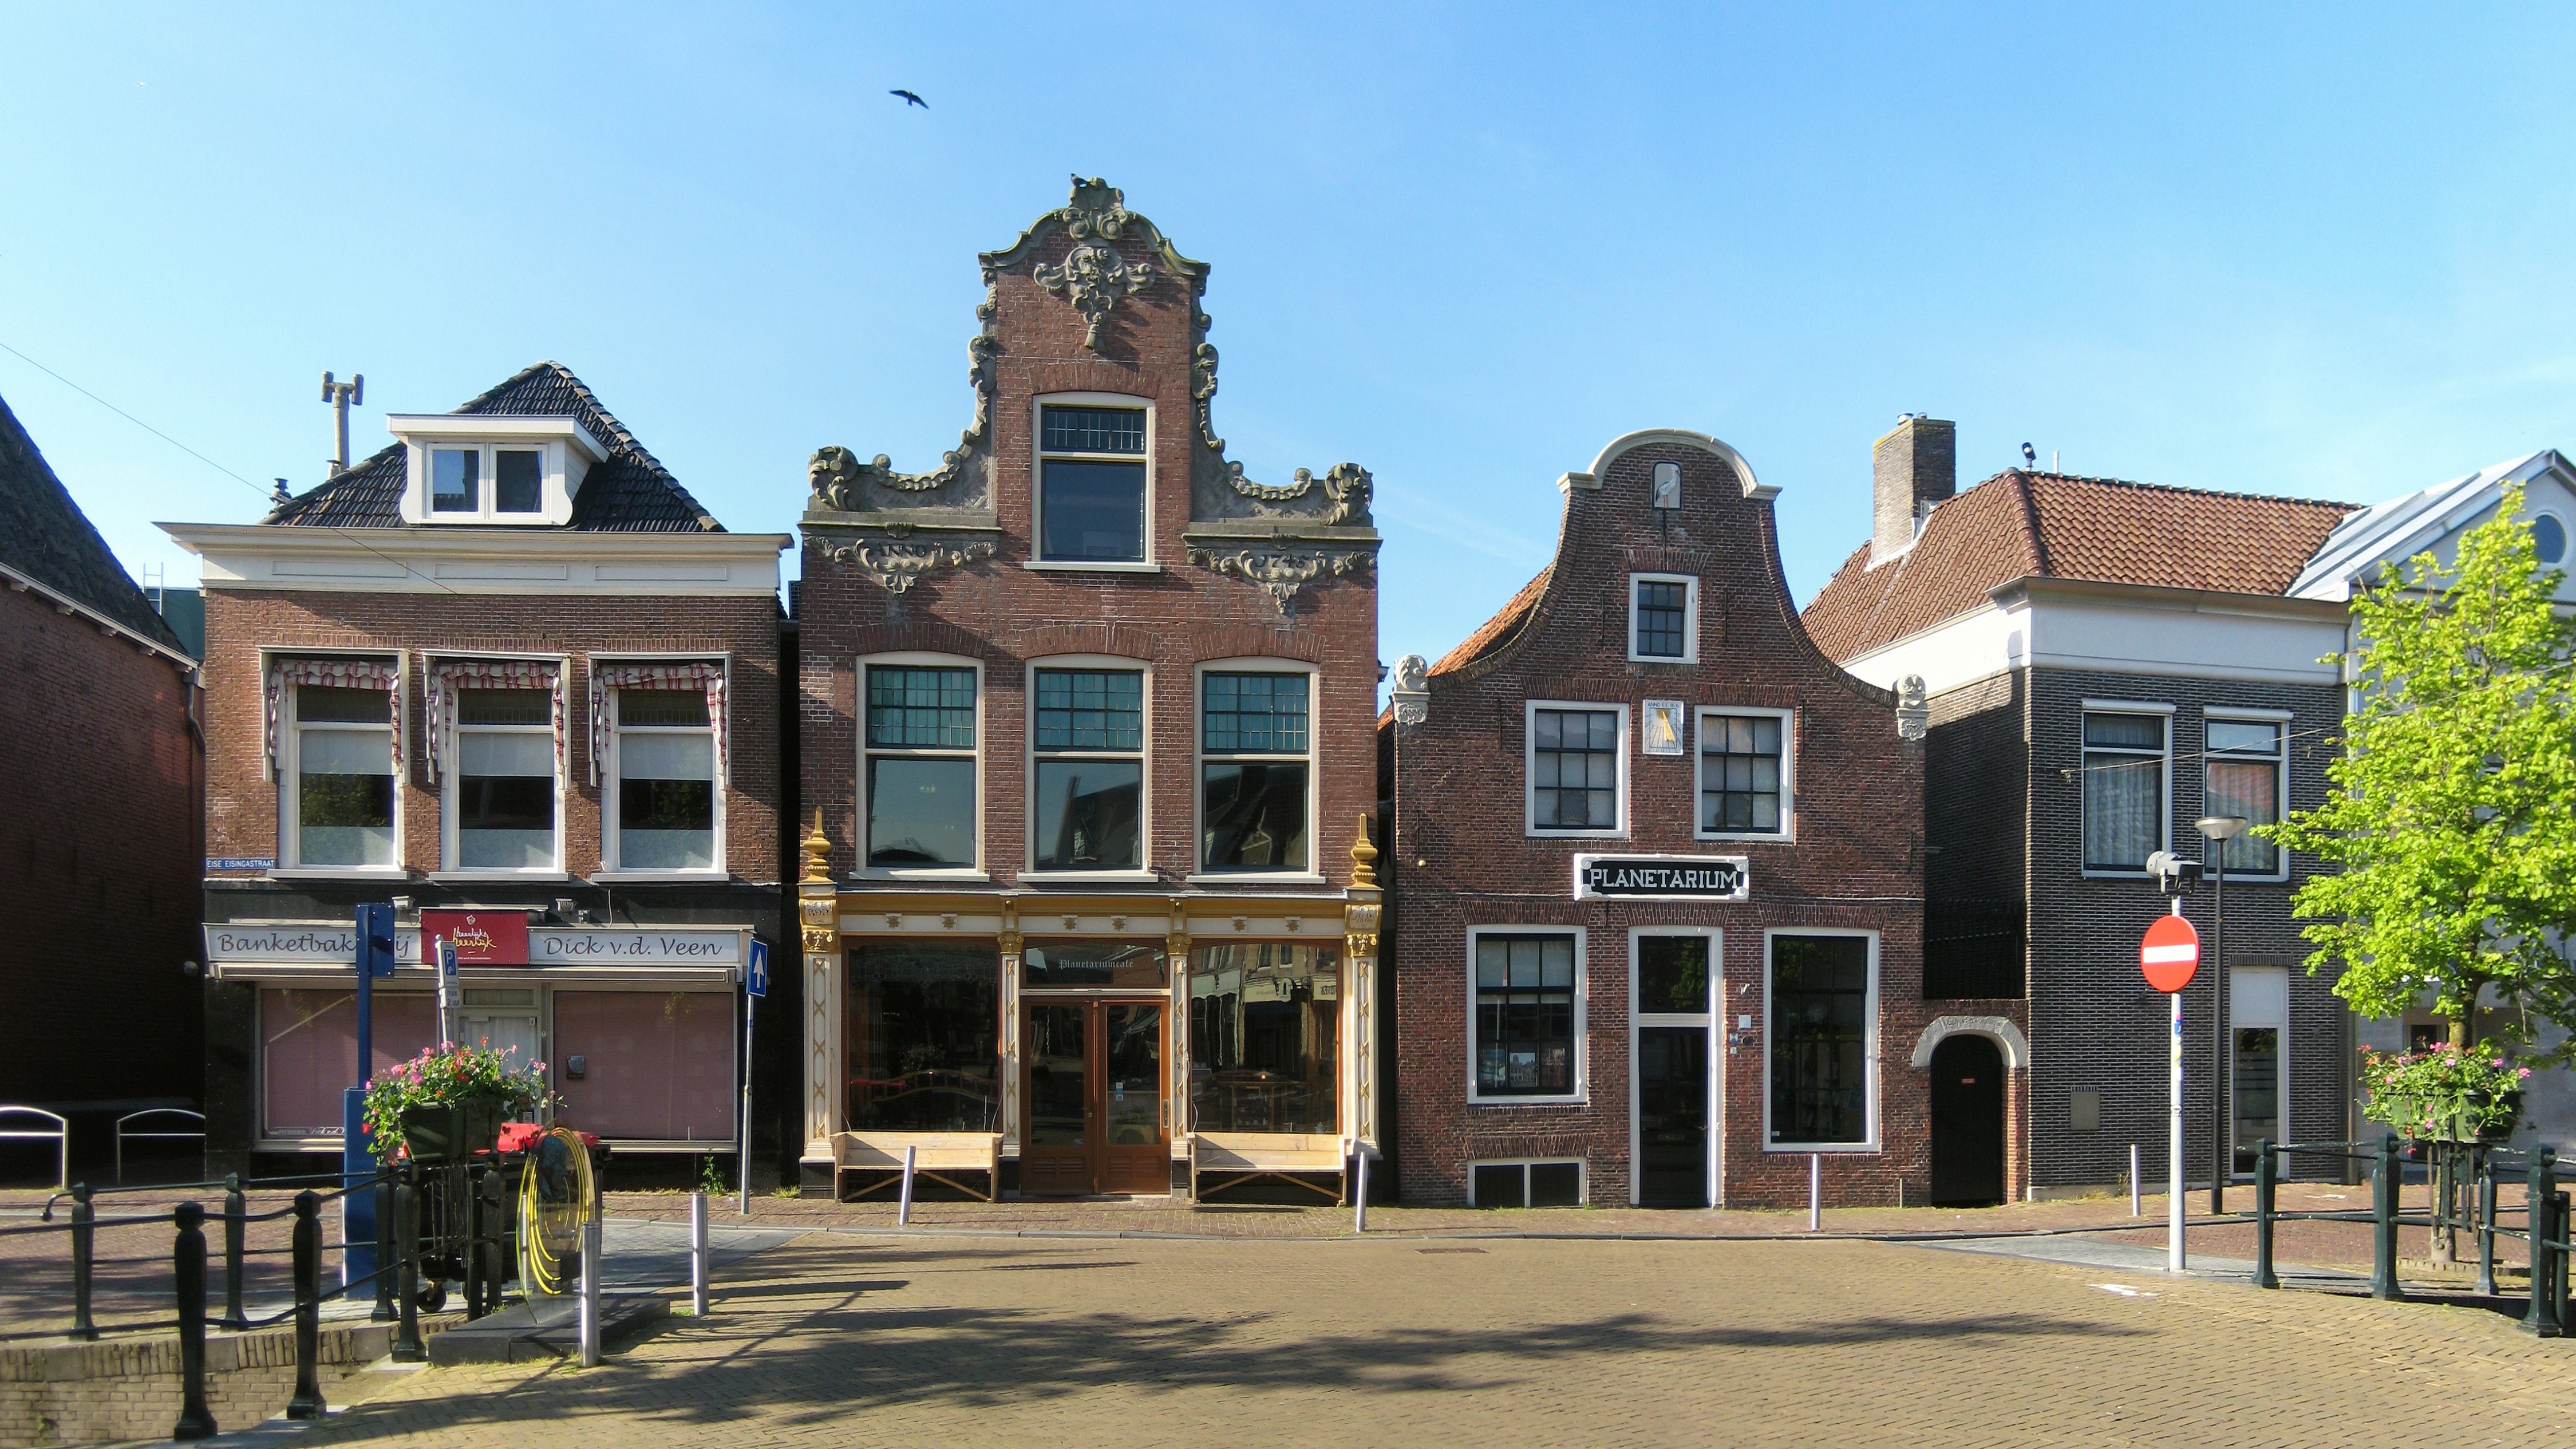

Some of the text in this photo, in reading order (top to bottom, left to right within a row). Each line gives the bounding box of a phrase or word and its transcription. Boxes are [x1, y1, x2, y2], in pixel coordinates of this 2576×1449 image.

[871, 543, 926, 557] ANNO
[1590, 869, 1737, 889] PLANETARIUM
[218, 933, 411, 958] Banketbakij
[452, 927, 497, 952] heerlijk
[544, 936, 722, 956] Dick v.d. Veen
[1059, 958, 1133, 969] Planetariumcafé
